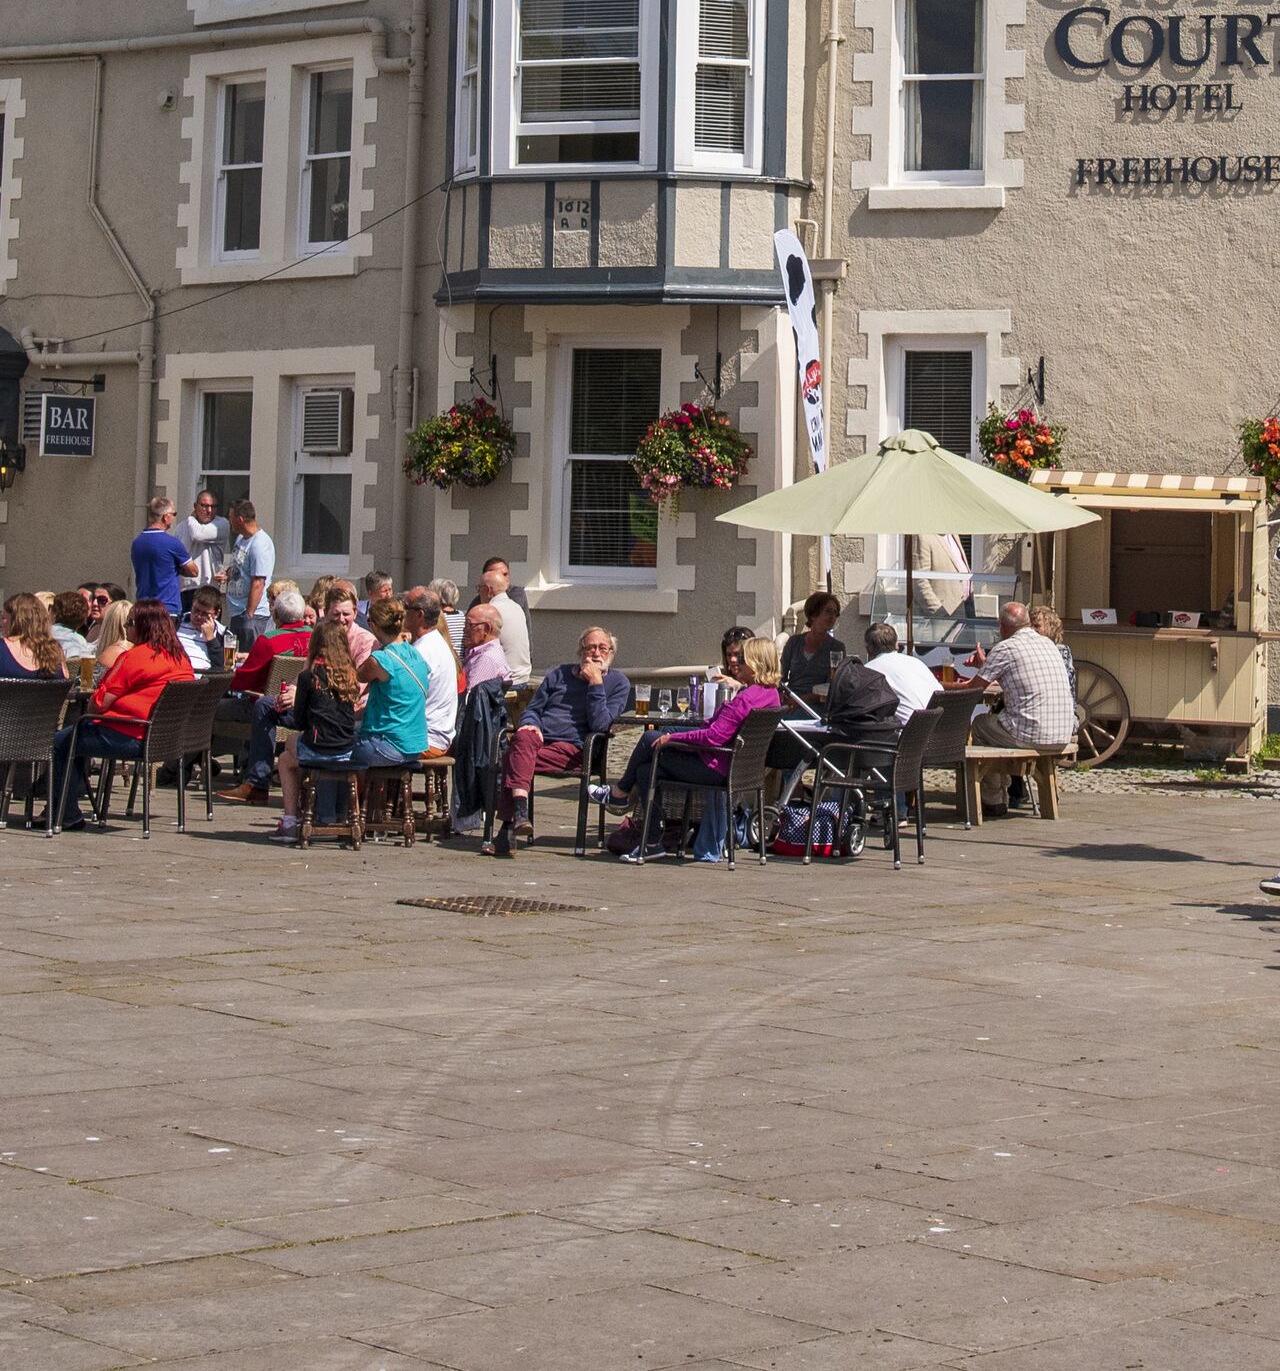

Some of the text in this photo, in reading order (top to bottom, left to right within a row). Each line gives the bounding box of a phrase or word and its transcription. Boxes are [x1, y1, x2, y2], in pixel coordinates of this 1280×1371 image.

[1122, 83, 1243, 112] HOTEL
[49, 406, 89, 431] BAR
[45, 434, 91, 446] FREEHOUSE
